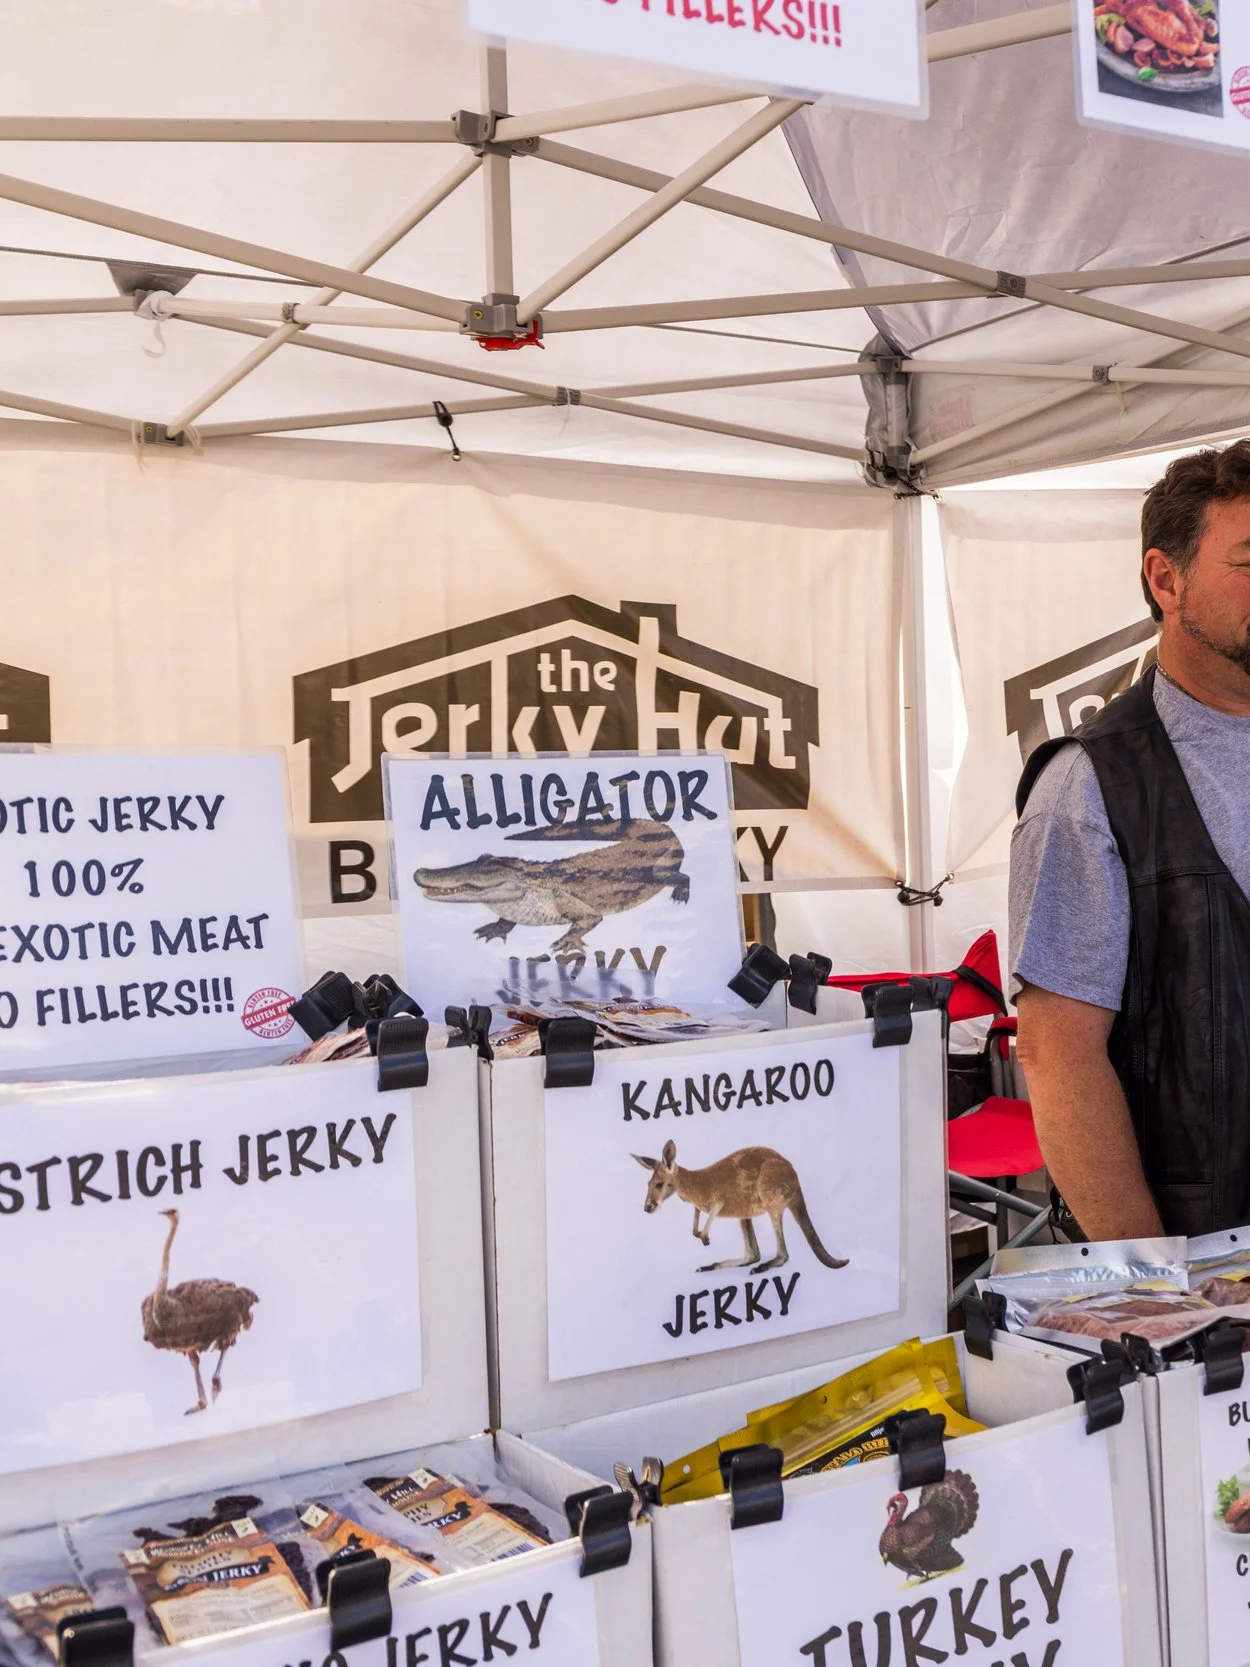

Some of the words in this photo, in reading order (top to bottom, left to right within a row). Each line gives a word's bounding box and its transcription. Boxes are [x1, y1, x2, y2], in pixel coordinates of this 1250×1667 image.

[642, 0, 842, 47] LLERS!!!
[538, 648, 618, 693] the
[636, 640, 797, 770] Hut
[88, 794, 225, 834] JERKY
[419, 768, 719, 831] ALLIGATOR
[23, 857, 145, 898] 100%
[149, 912, 270, 956] MEAT
[36, 976, 235, 1027] FILLERS!!!
[495, 944, 668, 1008] JERKY
[244, 1008, 277, 1026] GLUTEN
[621, 1059, 836, 1122] KANGAROO
[0, 1139, 203, 1214] STRICH
[222, 1112, 397, 1186] JERKY
[662, 1271, 801, 1338] JERKY
[213, 1564, 263, 1583] JERKY
[800, 1548, 1074, 1667] TURKEY
